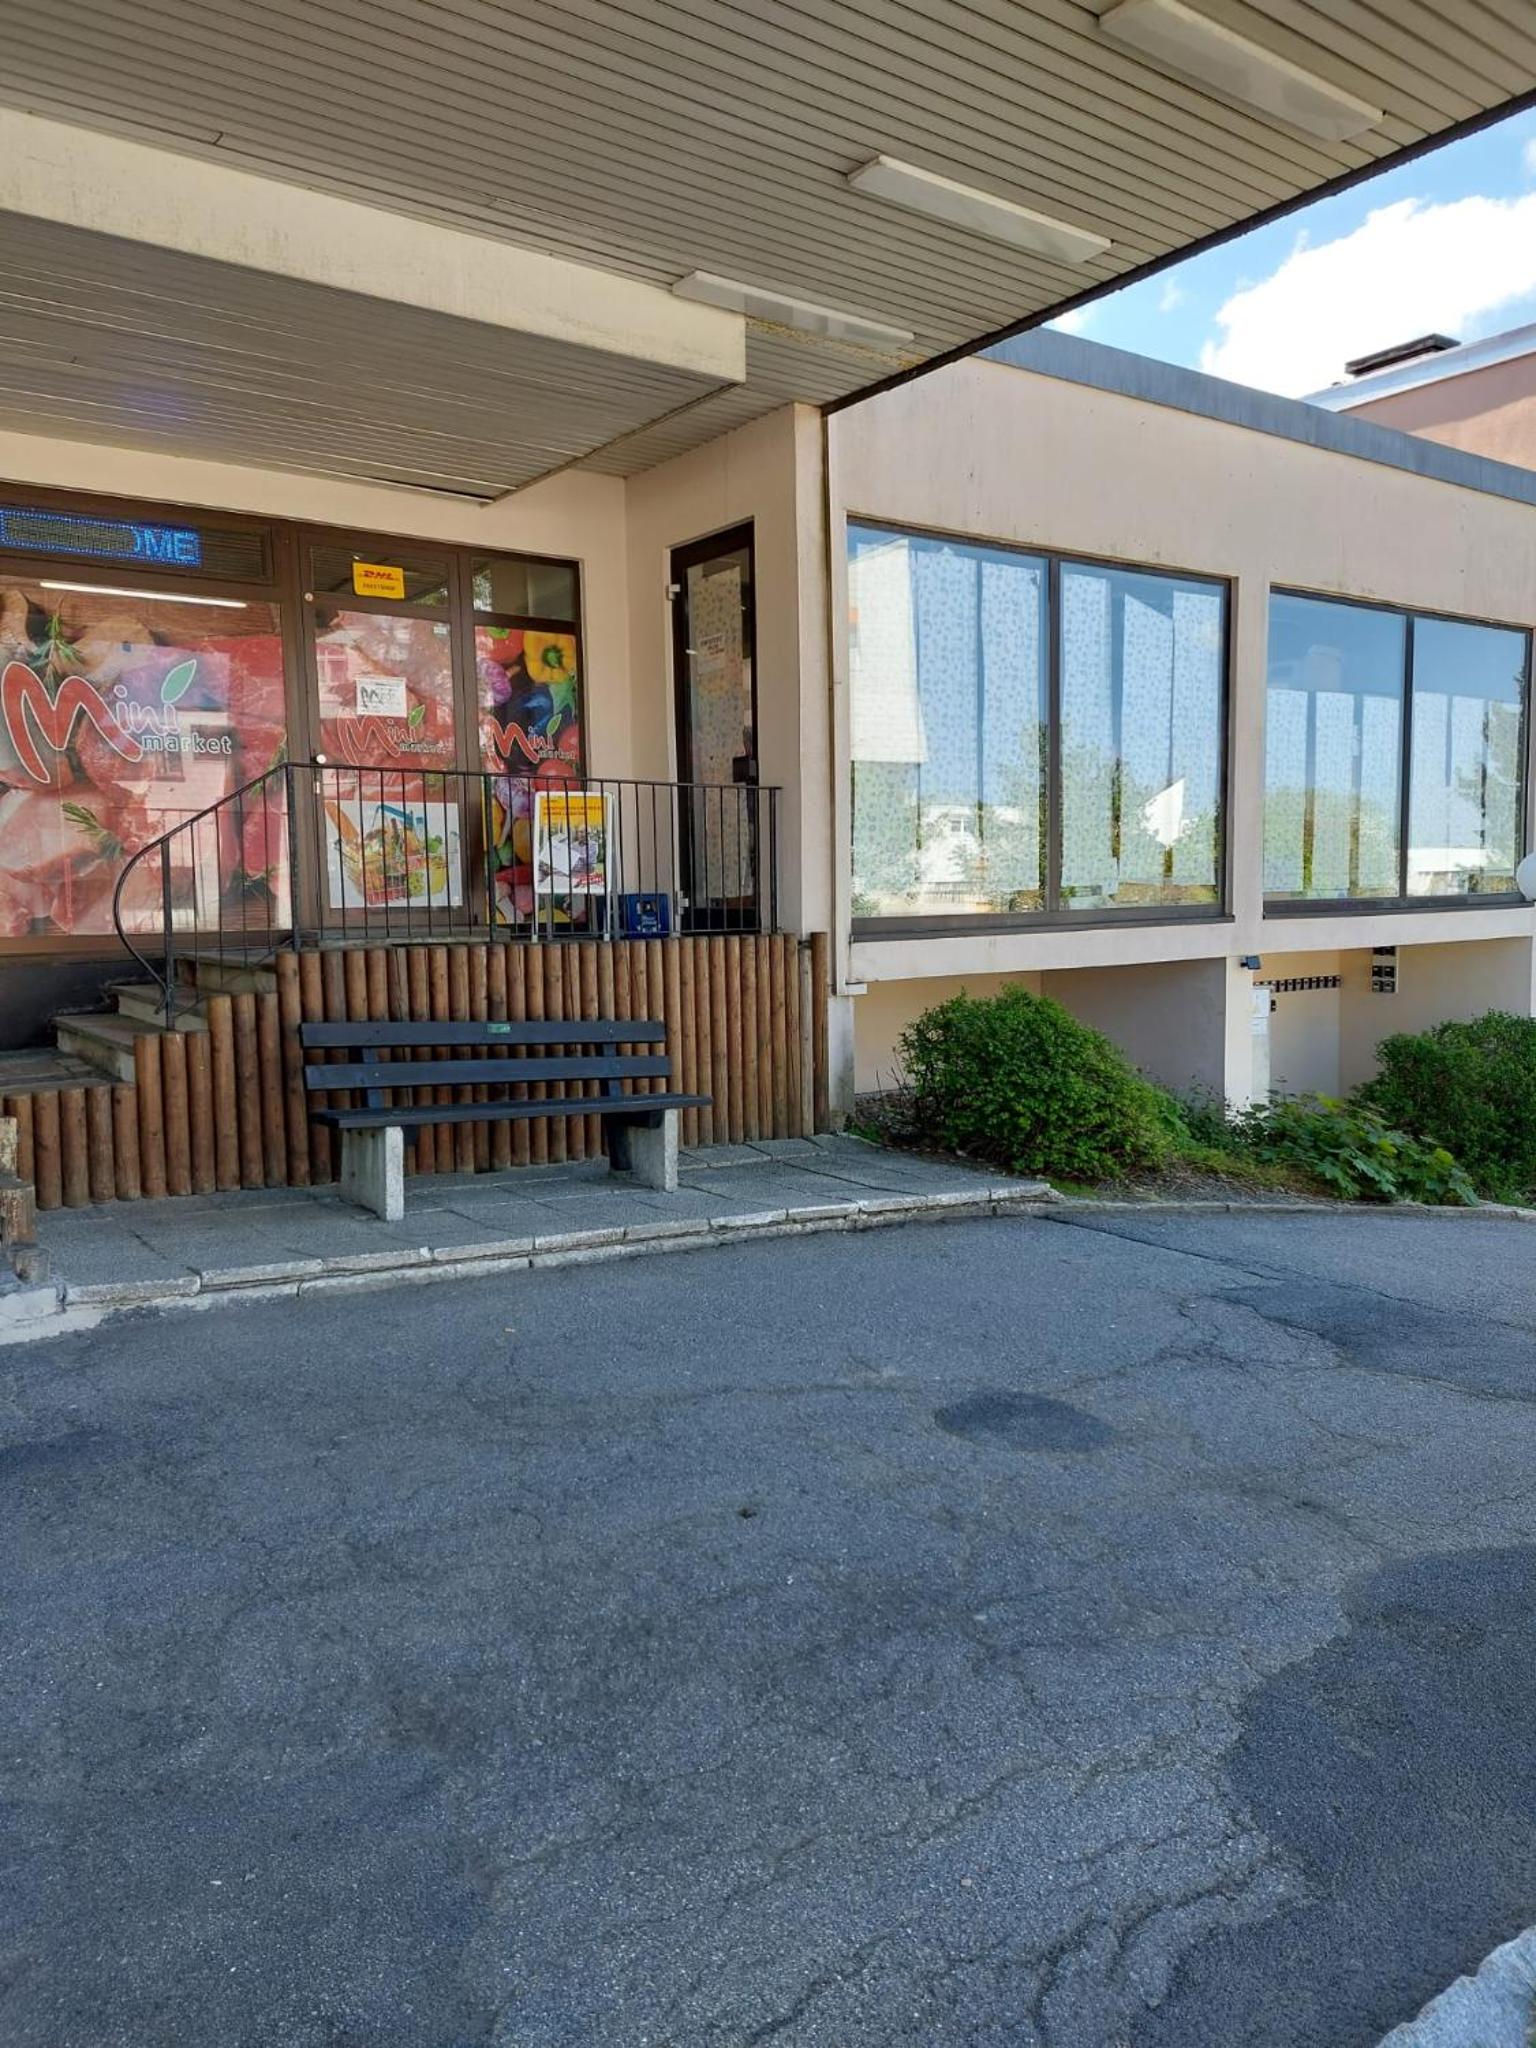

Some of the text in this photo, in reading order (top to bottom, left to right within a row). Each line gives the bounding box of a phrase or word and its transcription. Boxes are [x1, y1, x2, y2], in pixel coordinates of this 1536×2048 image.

[363, 570, 394, 580] DHL
[1, 659, 190, 783] Mini
[142, 733, 232, 755] market
[337, 705, 421, 767] Mini
[484, 714, 559, 772] Mini
